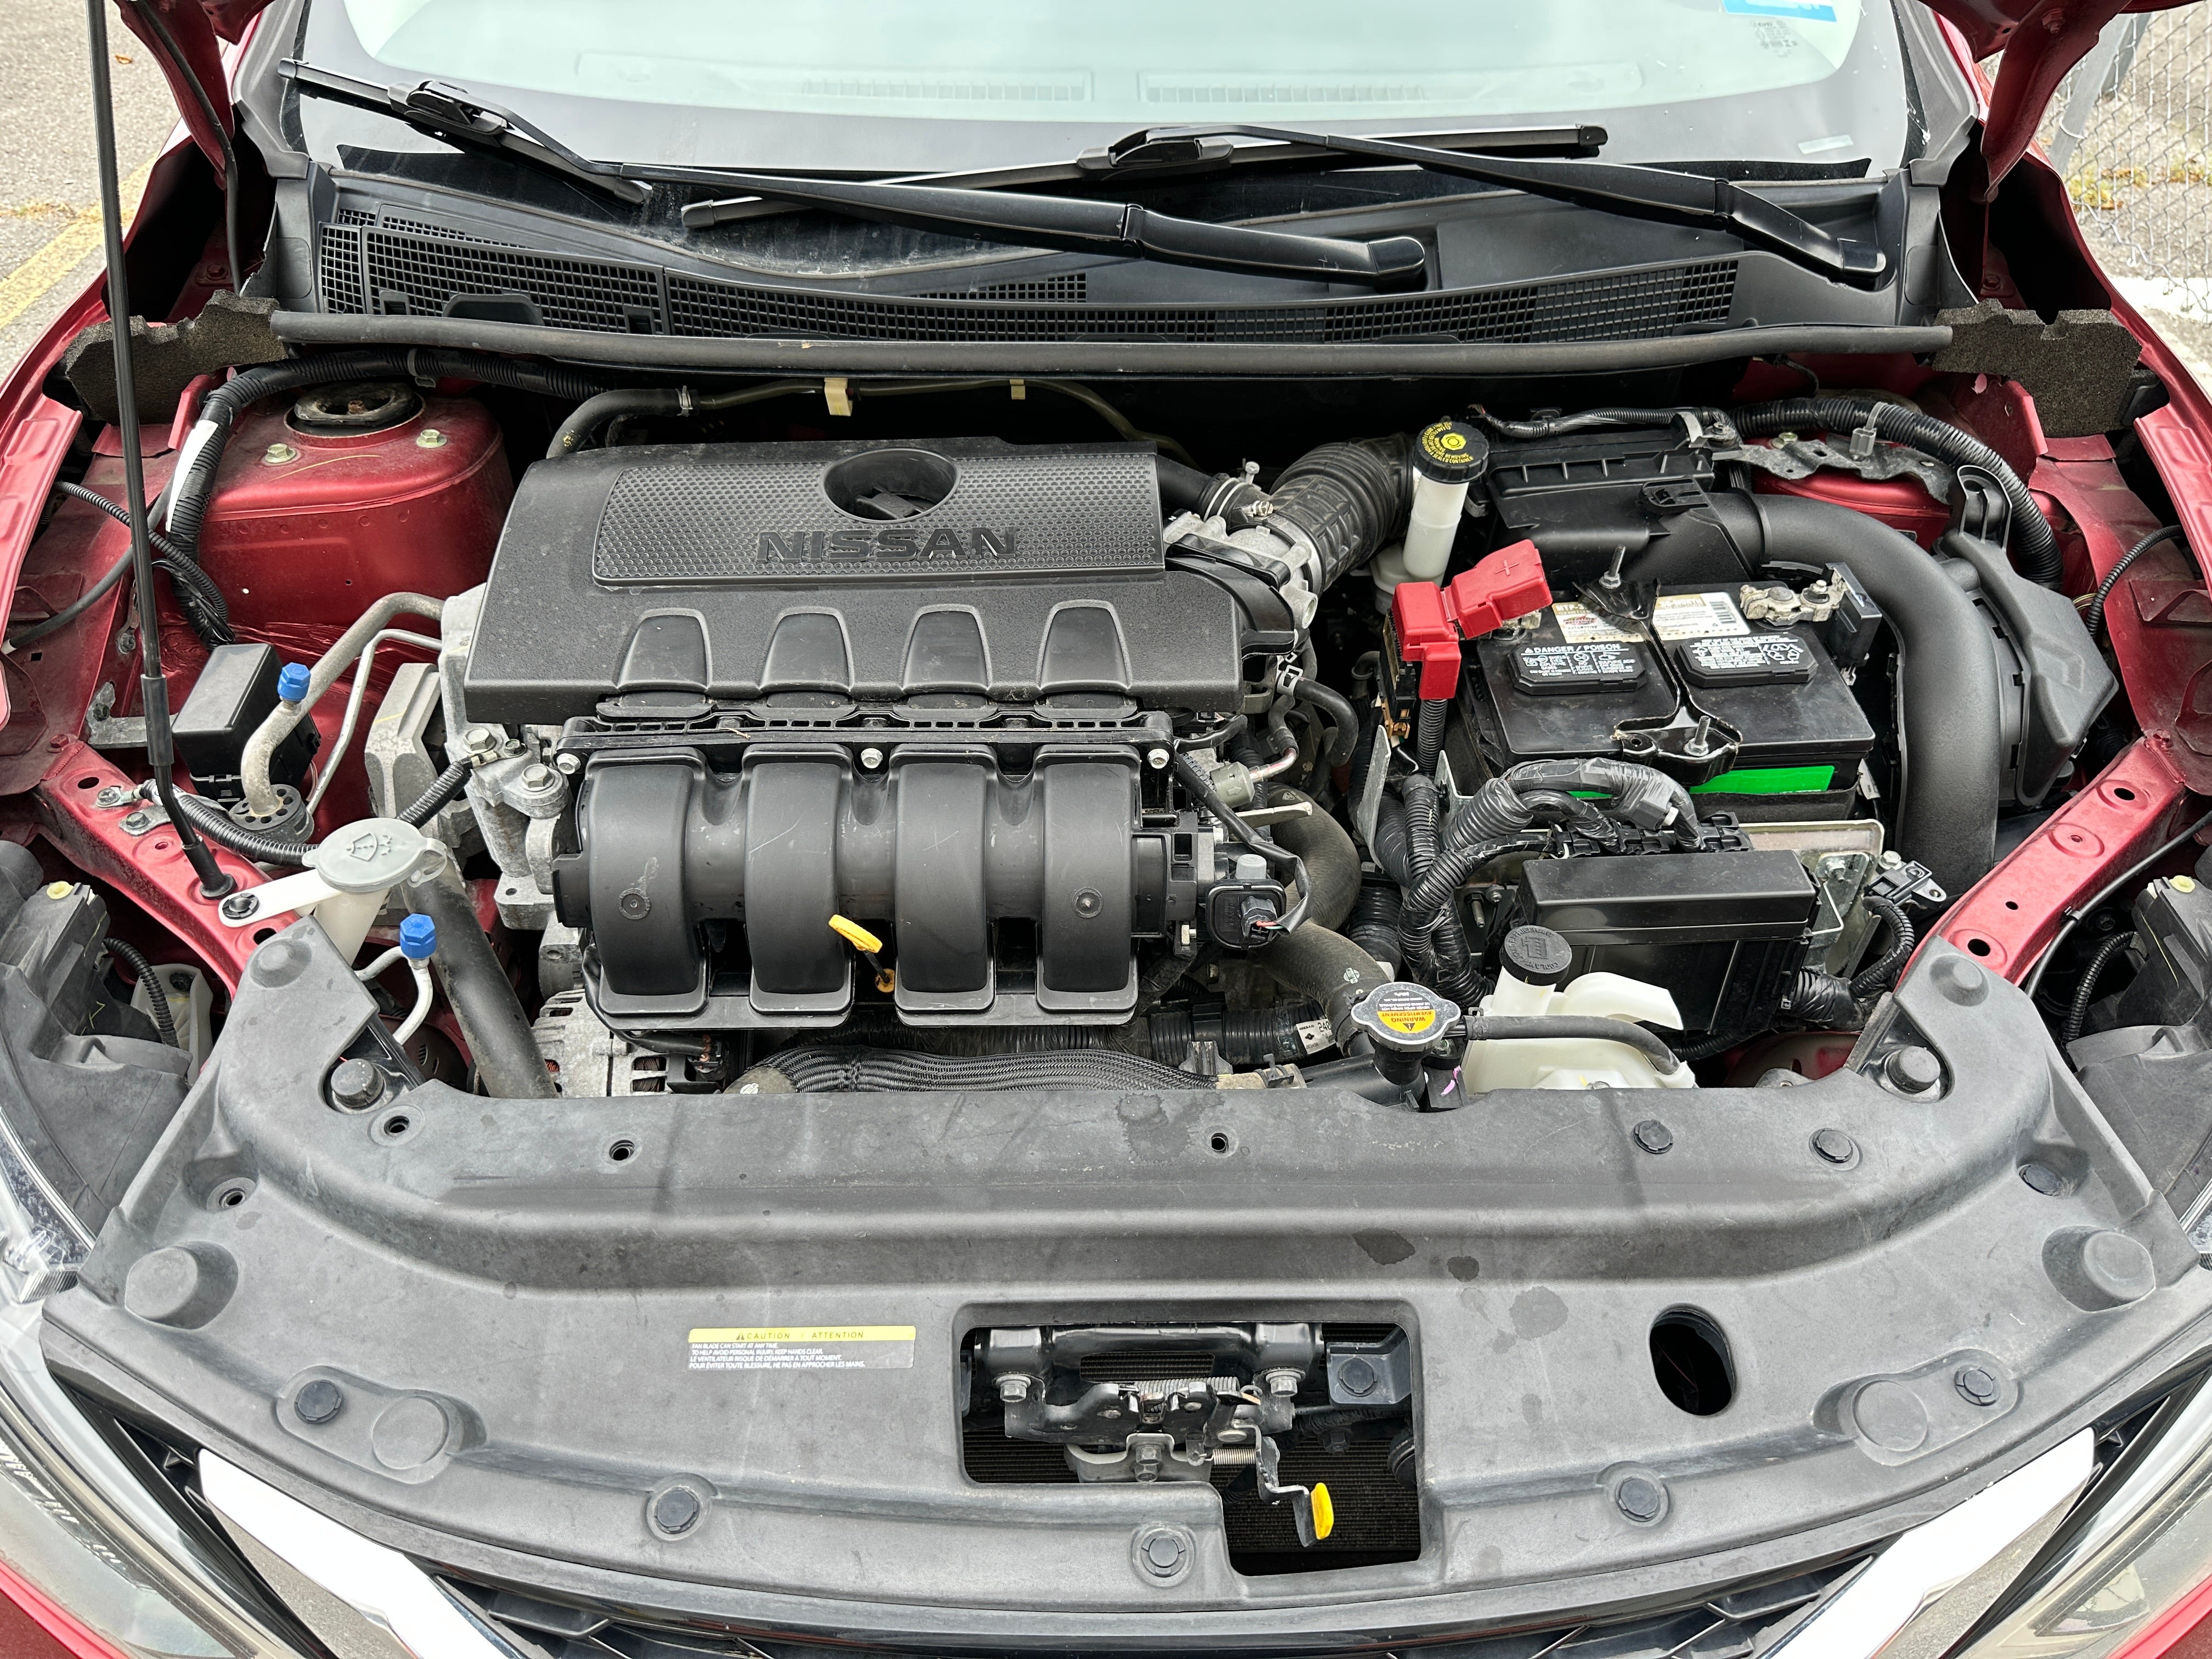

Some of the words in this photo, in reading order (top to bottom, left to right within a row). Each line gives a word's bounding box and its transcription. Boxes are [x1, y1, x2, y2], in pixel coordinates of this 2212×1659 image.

[1431, 453, 1449, 463] SEALED
[1448, 455, 1475, 464] CONTAINER
[757, 527, 1016, 562] NISSAN
